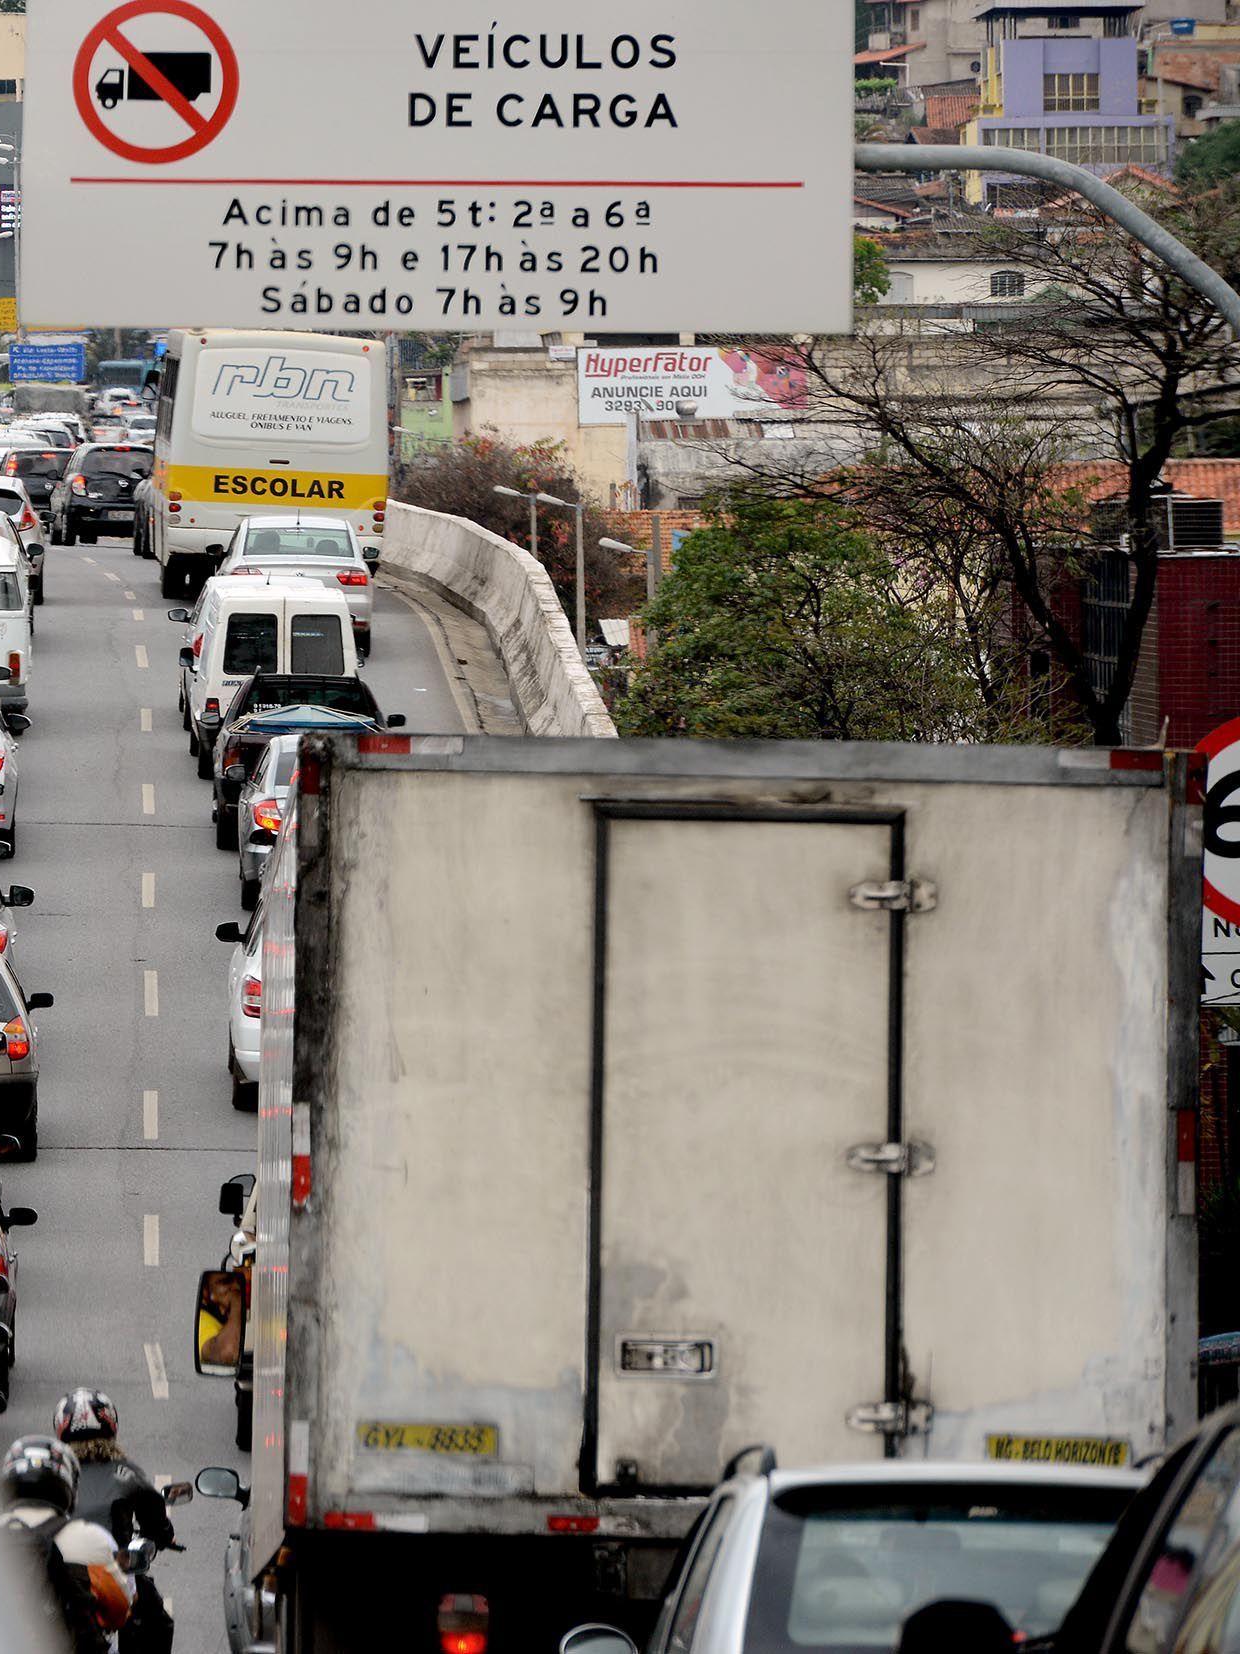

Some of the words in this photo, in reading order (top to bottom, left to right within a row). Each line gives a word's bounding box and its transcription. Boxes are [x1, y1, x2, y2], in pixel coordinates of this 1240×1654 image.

[415, 21, 677, 70] VEÍCULOS
[408, 92, 473, 128] DE
[496, 92, 679, 129] CARGA
[222, 198, 350, 227] Acima
[372, 199, 415, 228] de
[512, 200, 555, 228] 2ª
[571, 207, 590, 228] a
[605, 200, 651, 228] 6ª
[208, 241, 254, 269] 7h
[269, 237, 313, 270] às
[333, 243, 378, 271] 9h
[401, 250, 419, 271] e
[441, 244, 503, 272] 17h
[519, 240, 563, 273] às
[580, 245, 658, 274] 20h
[261, 280, 413, 315] Sábado
[436, 288, 481, 315] 7h
[498, 283, 541, 316] às
[559, 288, 607, 317] 9h
[212, 356, 354, 402] rbn
[585, 352, 712, 378] Hyperfator
[591, 385, 663, 399] ANUNCIE
[669, 385, 708, 399] AQUI
[251, 413, 307, 423] FRETAMENTO
[286, 423, 293, 431] E
[213, 474, 345, 499] ESCOLAR
[1022, 1439, 1052, 1463] BELO
[1054, 1439, 1121, 1466] HORIZONTE
